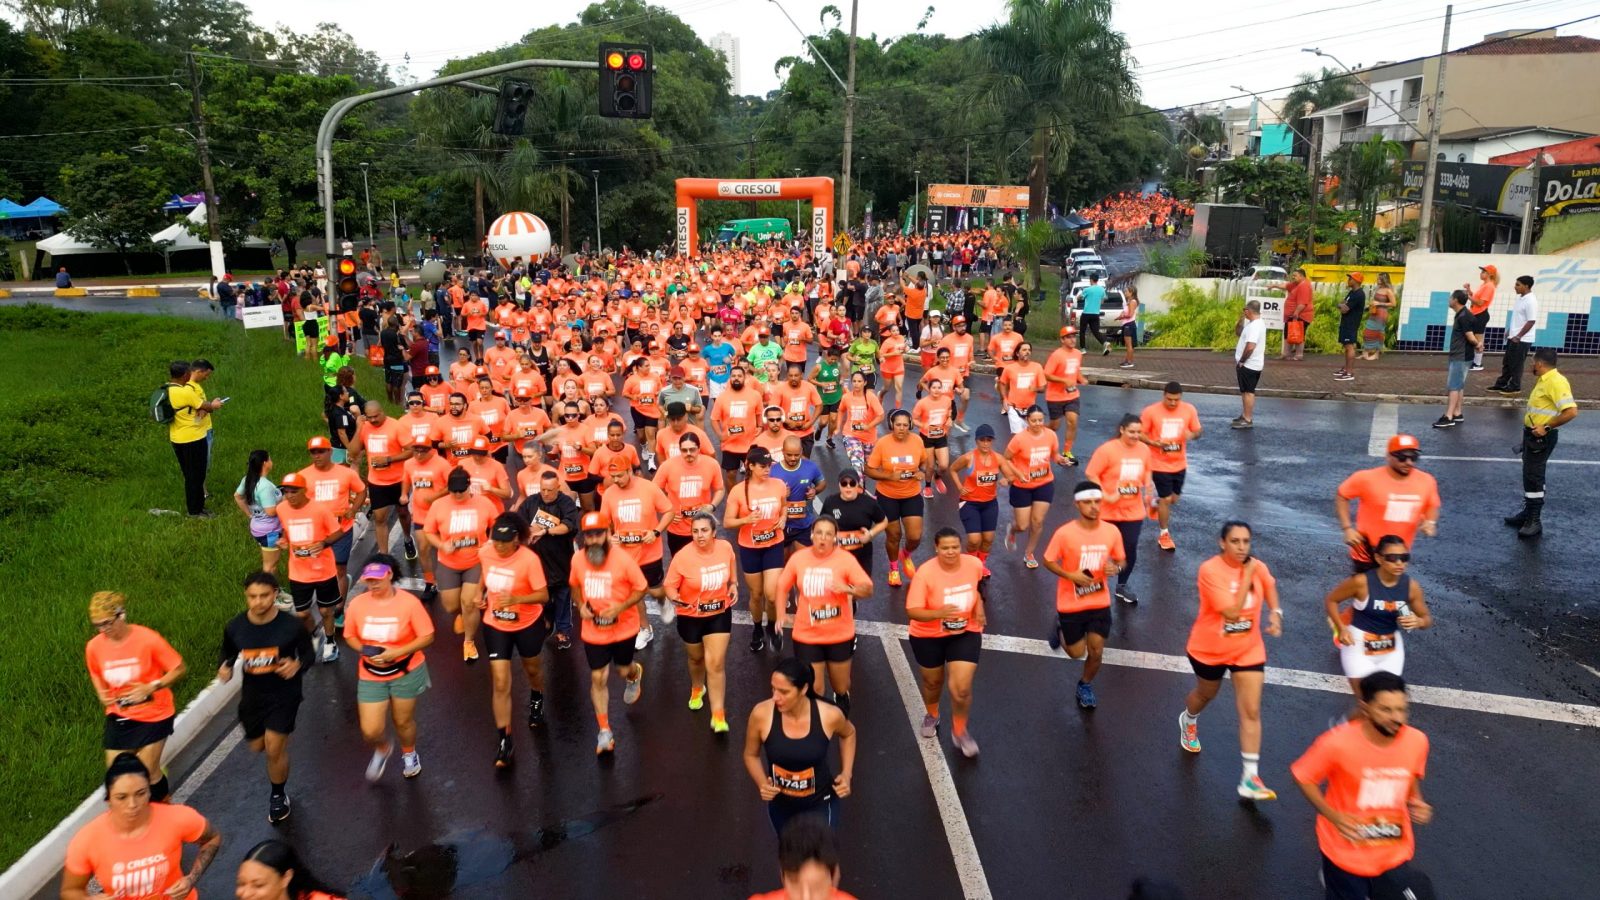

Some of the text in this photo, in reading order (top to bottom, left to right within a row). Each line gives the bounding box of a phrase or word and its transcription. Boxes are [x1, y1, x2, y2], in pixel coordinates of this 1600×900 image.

[1571, 169, 1590, 177] Lava
[735, 184, 779, 194] CRESOL
[970, 188, 987, 204] RUN
[1263, 301, 1281, 311] DR.
[701, 571, 723, 592] RUN
[779, 776, 808, 789] 1742
